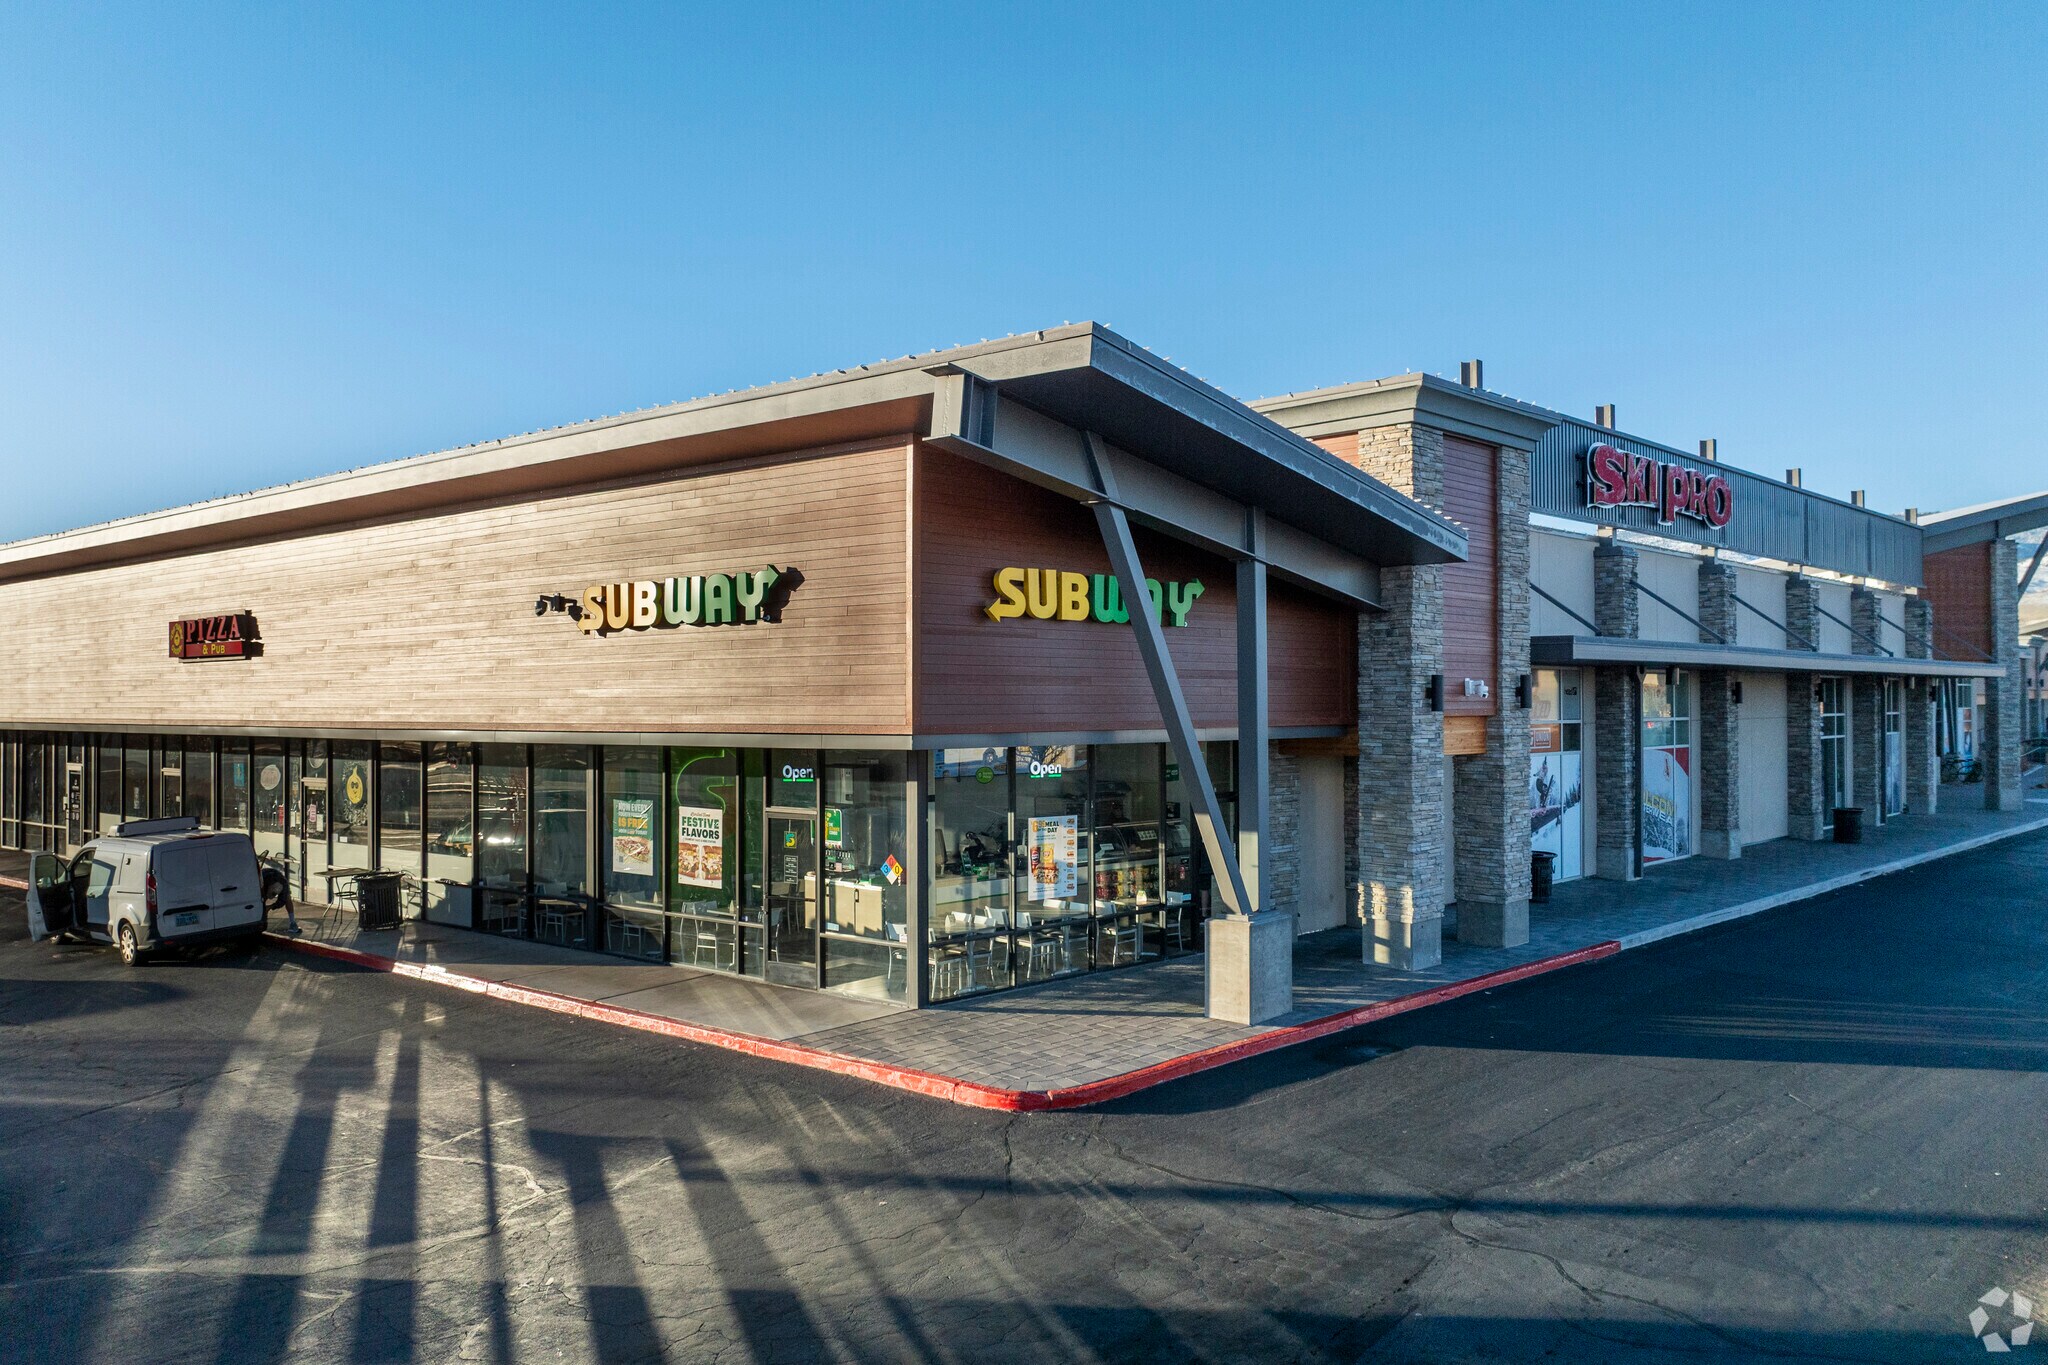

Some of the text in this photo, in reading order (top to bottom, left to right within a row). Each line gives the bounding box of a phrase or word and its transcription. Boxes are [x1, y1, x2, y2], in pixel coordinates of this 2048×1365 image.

[1587, 443, 1732, 528] SKI PRO
[577, 564, 780, 635] SUBWAY
[186, 615, 240, 642] PIZZA
[202, 645, 208, 655] &
[782, 764, 814, 782] Open
[1030, 760, 1062, 778] Open
[618, 817, 627, 828] IS
[681, 827, 720, 840] FLAVORS
[883, 864, 889, 874] 3
[894, 865, 900, 875] 0
